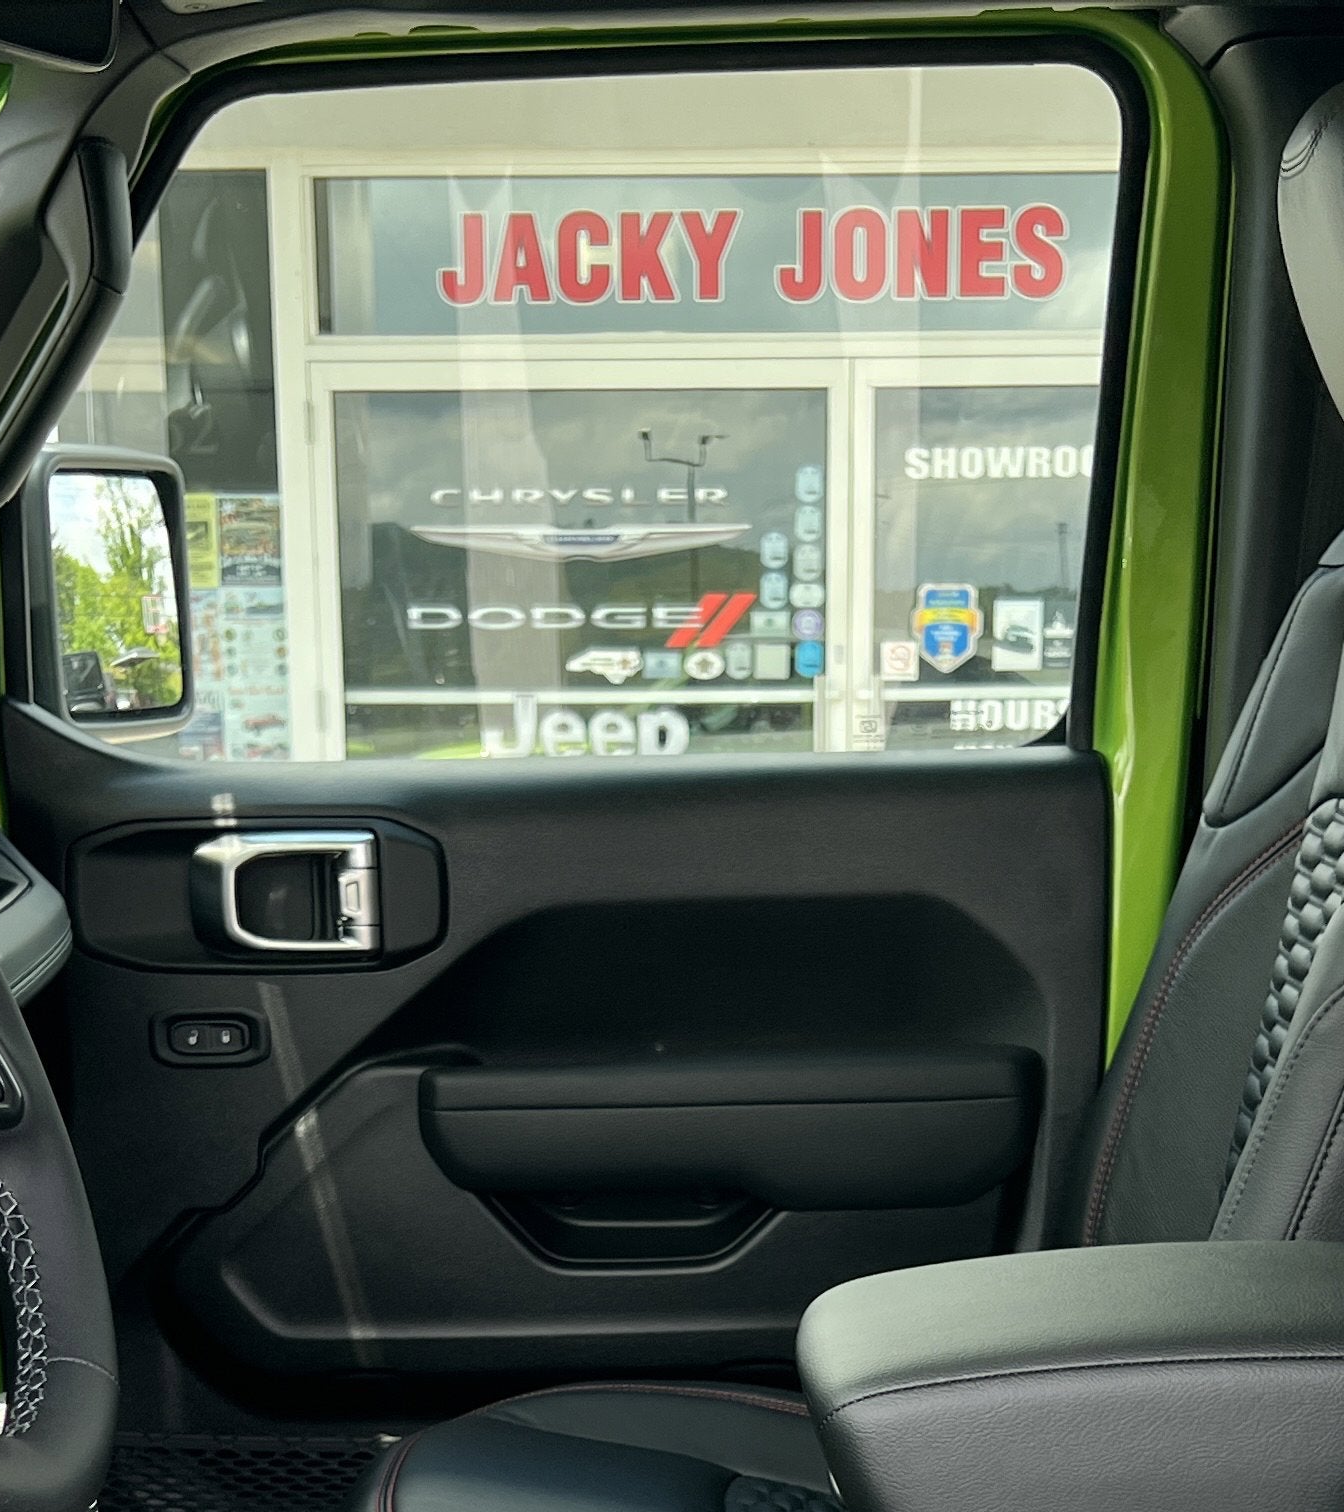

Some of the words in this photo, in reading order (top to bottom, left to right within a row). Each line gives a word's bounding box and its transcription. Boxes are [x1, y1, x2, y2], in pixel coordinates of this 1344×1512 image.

[437, 208, 741, 305] JACKY
[775, 204, 1069, 303] JONES
[430, 487, 729, 507] CHRYSLER
[407, 606, 704, 630] DODGE
[479, 694, 691, 758] Jeep
